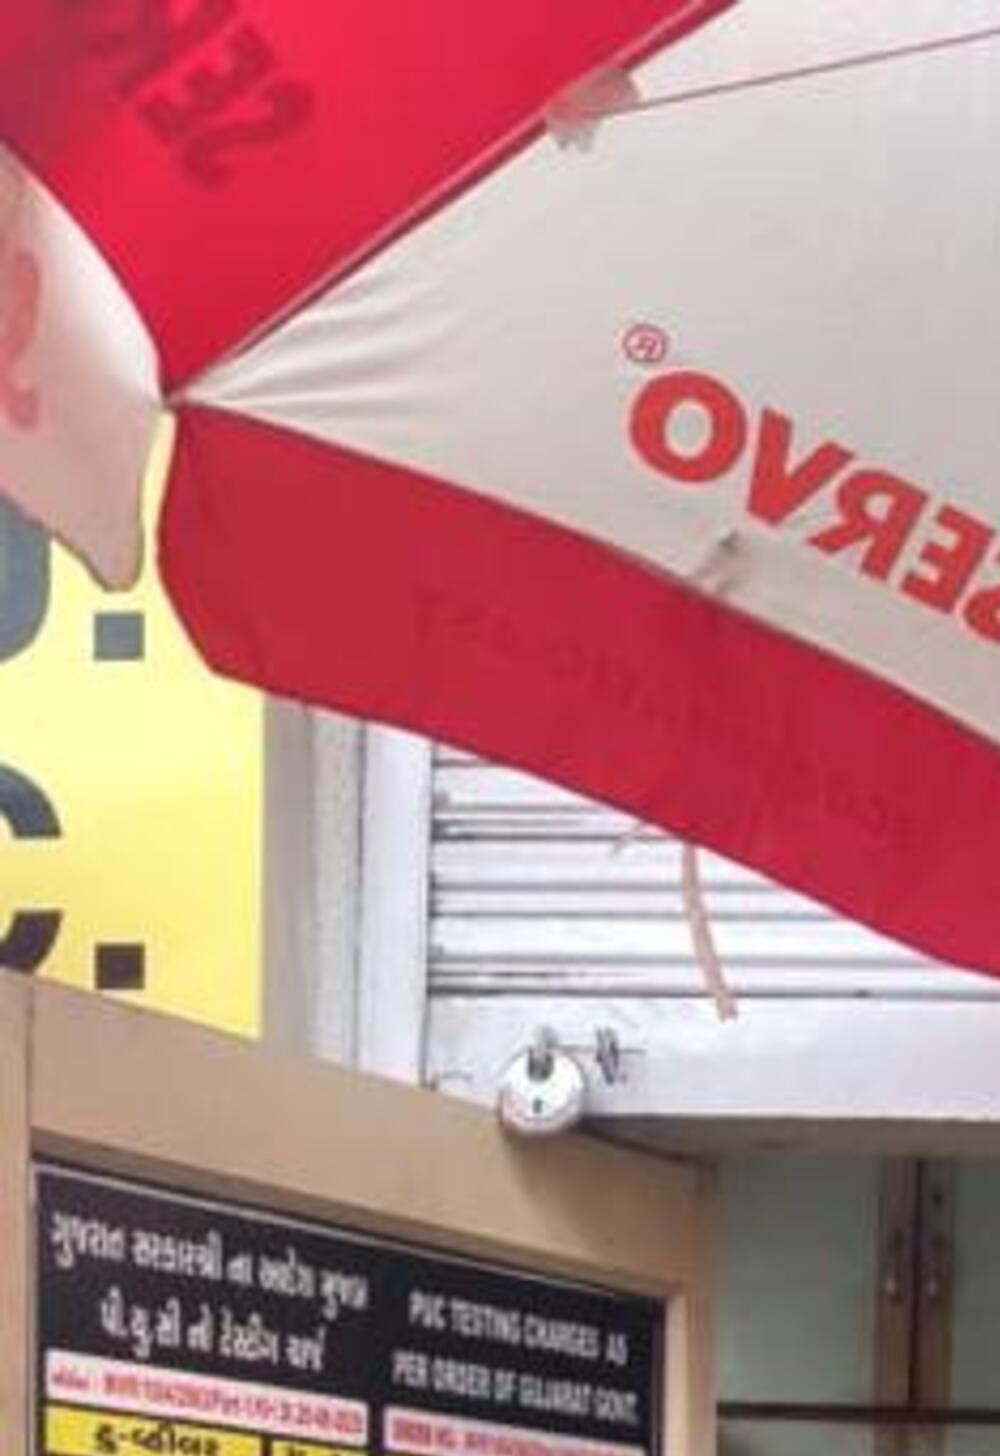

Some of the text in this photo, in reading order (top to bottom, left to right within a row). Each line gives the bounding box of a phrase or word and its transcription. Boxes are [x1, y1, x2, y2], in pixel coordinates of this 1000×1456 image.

[452, 1299, 521, 1345] TESTING
[524, 1314, 598, 1359] CHARGES
[392, 1350, 428, 1388] PER
[431, 1357, 491, 1400] ORDER
